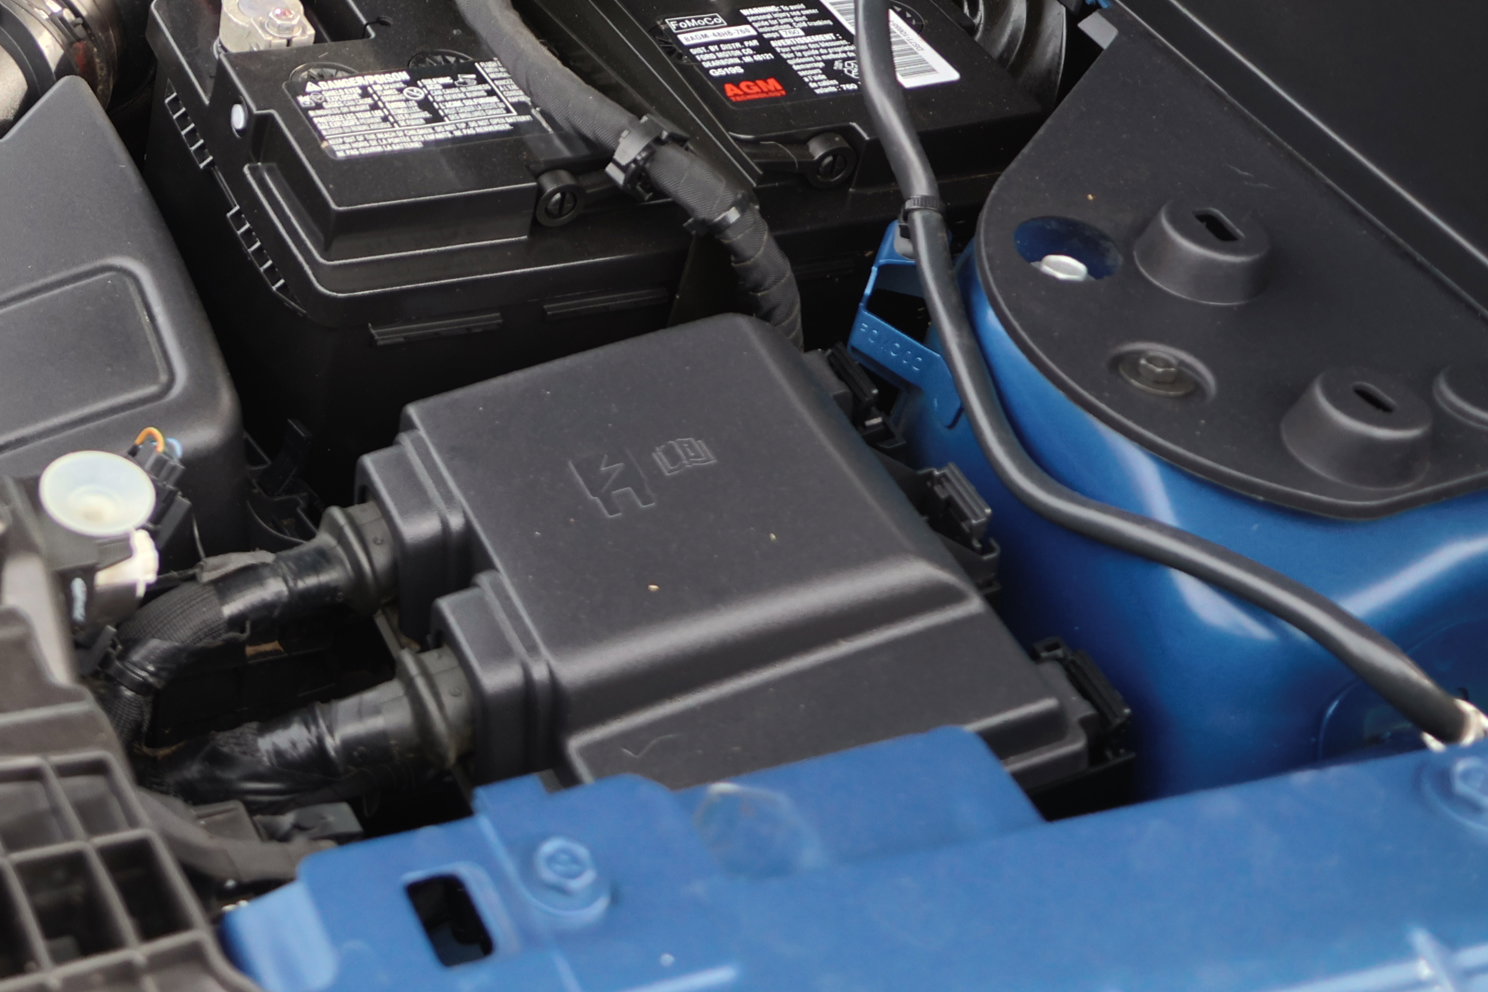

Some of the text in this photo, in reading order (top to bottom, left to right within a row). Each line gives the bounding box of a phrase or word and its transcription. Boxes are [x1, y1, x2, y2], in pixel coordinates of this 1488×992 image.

[670, 16, 723, 30] FoMoCo
[695, 52, 717, 61] FORD
[724, 77, 783, 97] AGM
